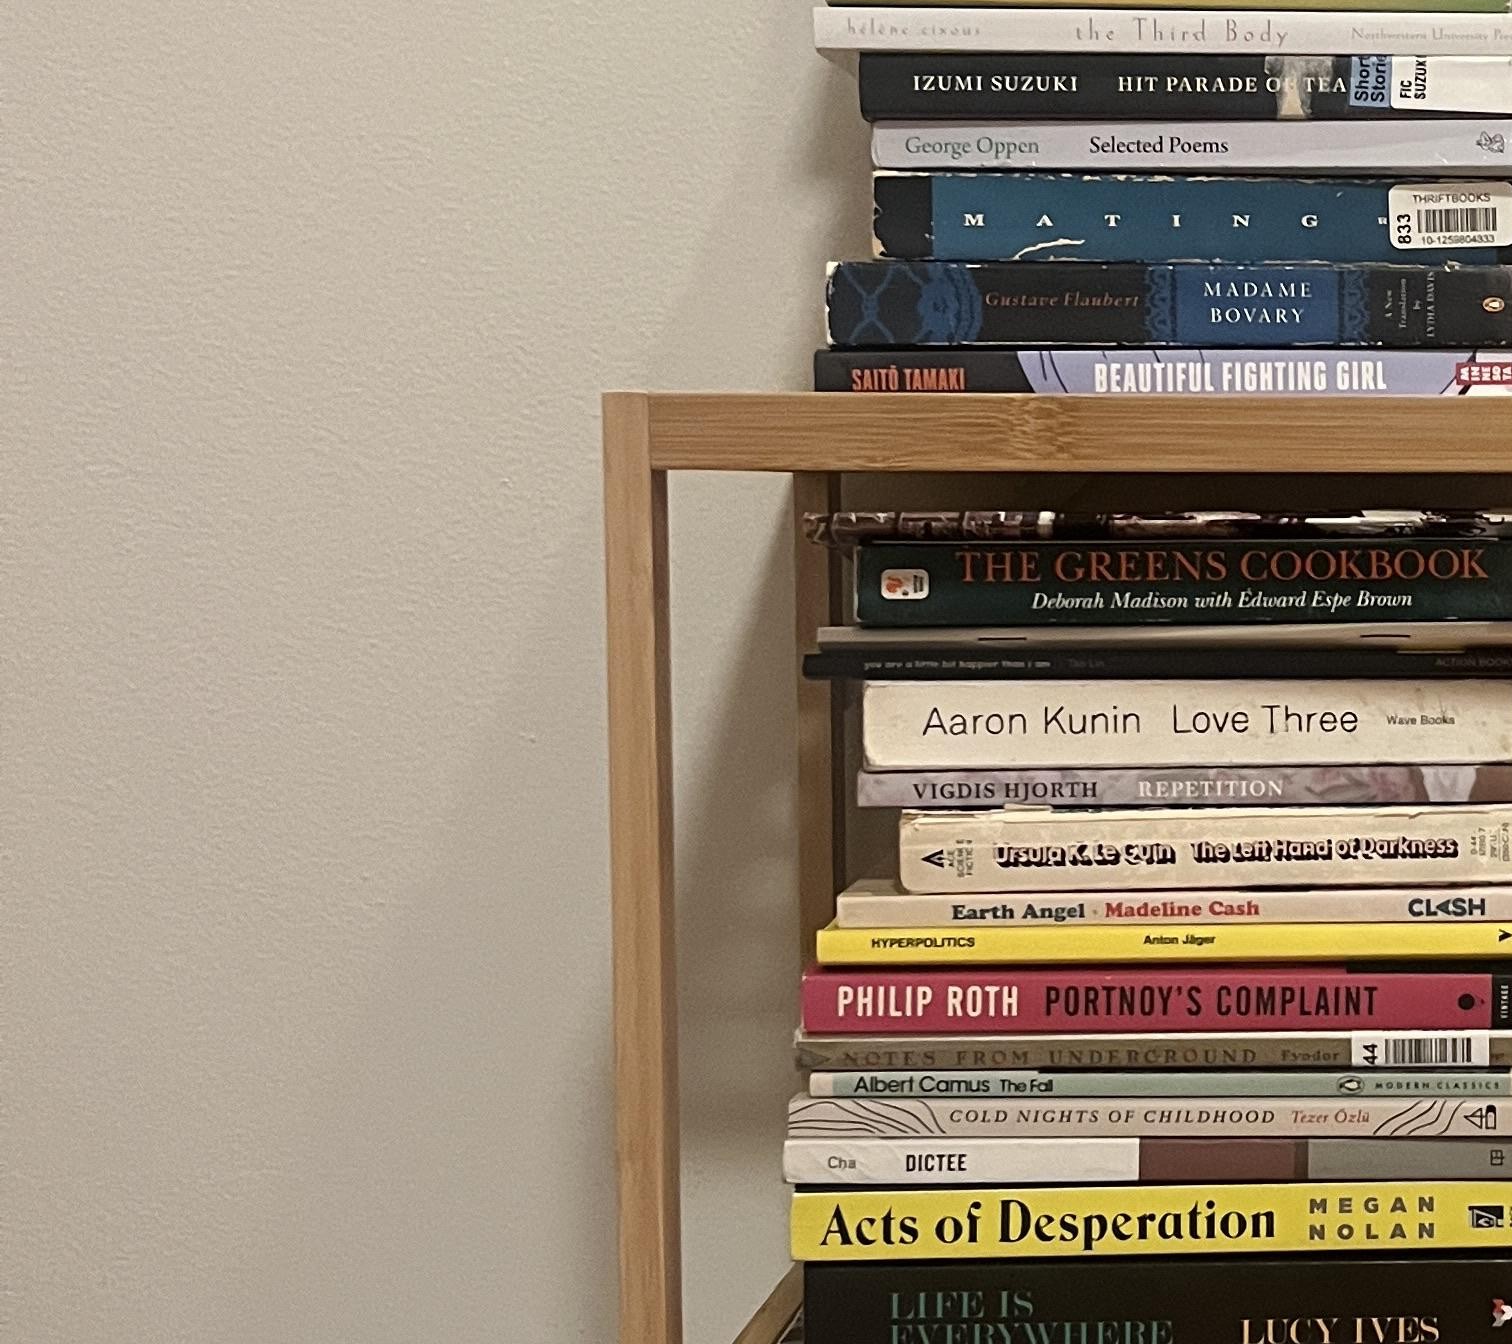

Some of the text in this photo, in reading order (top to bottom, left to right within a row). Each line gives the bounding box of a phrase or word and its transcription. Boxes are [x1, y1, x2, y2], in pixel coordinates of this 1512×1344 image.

[913, 75, 1079, 92] IZUMI SUZUKI
[1089, 134, 1229, 154] Selected Poems
[1412, 192, 1492, 203] THRIFTBOOKS
[1397, 213, 1412, 244] 833
[1204, 282, 1312, 298] MADAME
[1210, 307, 1305, 323] BOVARY
[1094, 361, 1387, 392] BEAUTIFUL FIGHTING GIRL
[922, 704, 1455, 737] Aaron Kunin Love Three Wave Books
[912, 780, 1284, 800] VIGDIS HJORTH REPETITION
[952, 900, 1259, 925] Earth Angel Madeline Cash
[872, 937, 975, 948] HYPERPOLITICS
[1144, 934, 1215, 946] Anton Jäger
[838, 987, 1379, 1016] PHILIP ROTH PORTNOY'S COMPLAINT
[854, 1077, 1054, 1094] Albert Camus The Fall
[1375, 1080, 1499, 1090] MODERN CLASSICS
[906, 1154, 967, 1172] DICTEE
[820, 1201, 1276, 1251] Acts of Desperation
